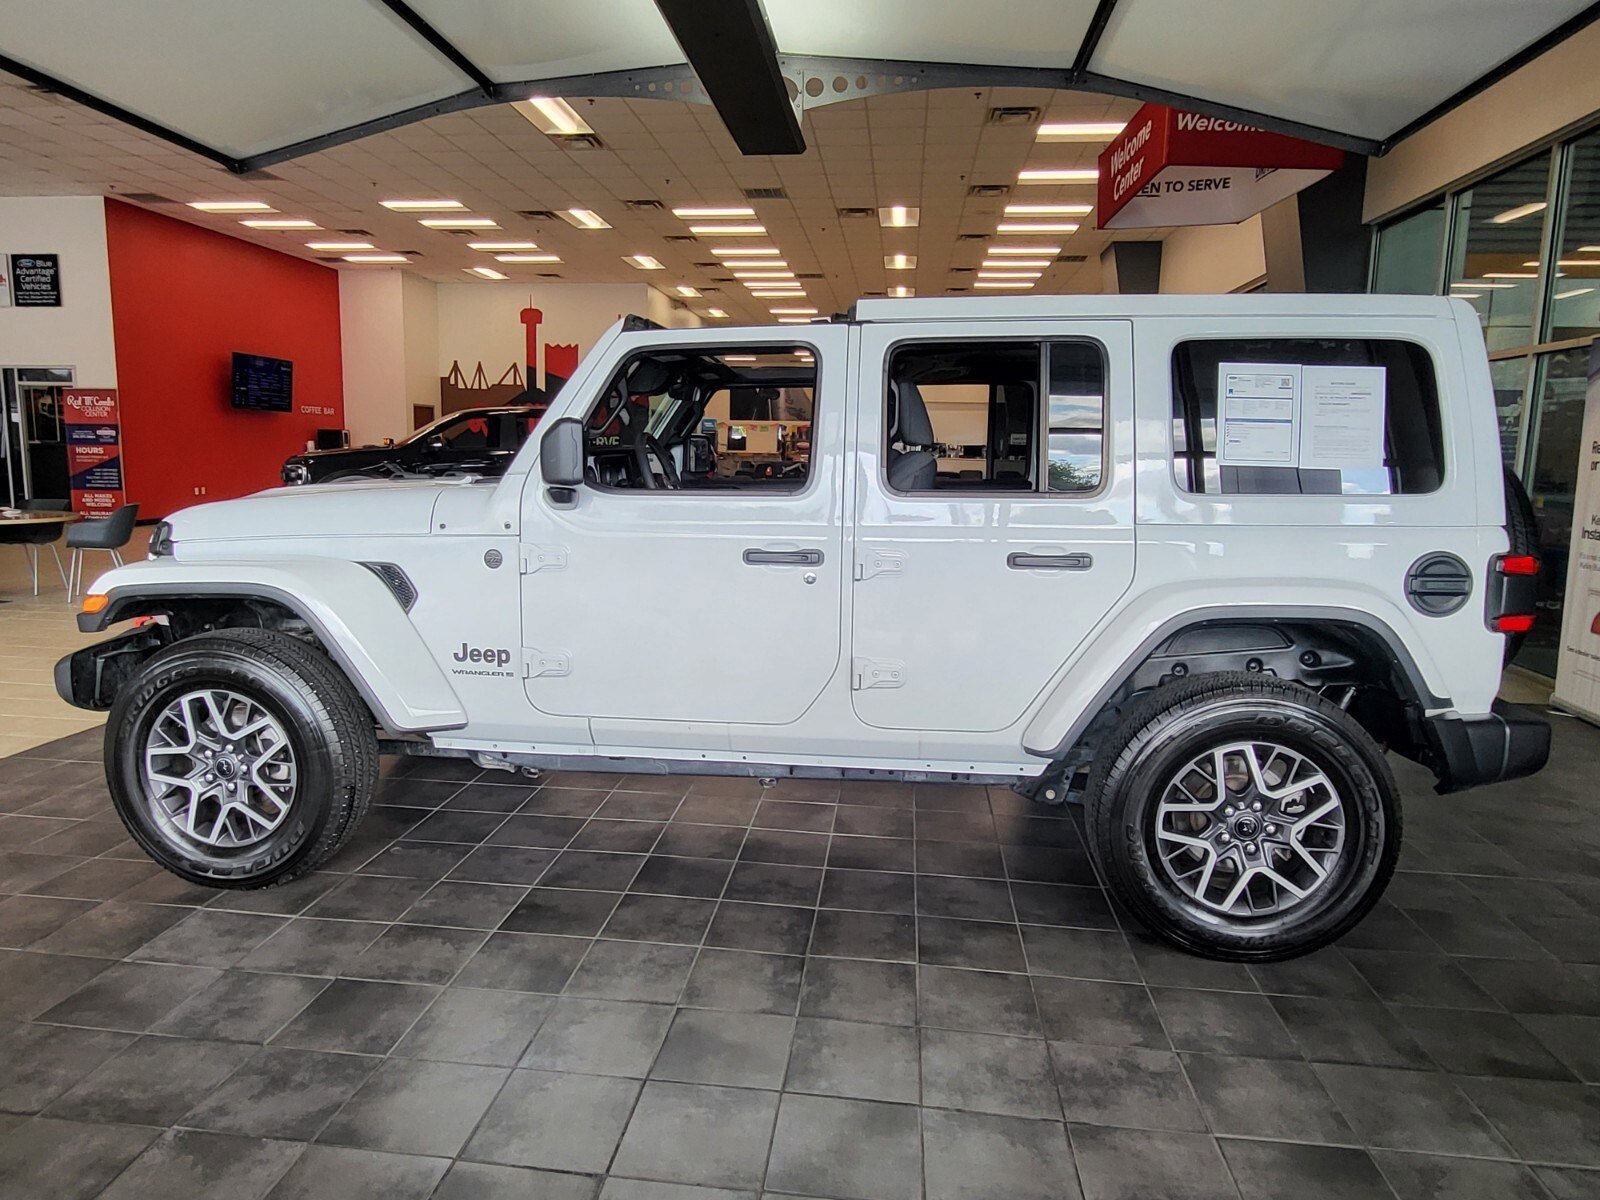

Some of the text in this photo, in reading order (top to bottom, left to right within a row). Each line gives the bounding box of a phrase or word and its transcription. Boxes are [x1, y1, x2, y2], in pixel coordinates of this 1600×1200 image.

[1177, 112, 1266, 132] Welcom
[1110, 120, 1152, 178] Welcome
[1113, 156, 1144, 201] Center
[1141, 177, 1231, 194] EN TO SERVE
[16, 268, 55, 276] Advantage
[301, 405, 335, 415] COFFEE BAR
[76, 446, 104, 454] HOURS
[453, 643, 510, 667] Jeep
[452, 669, 504, 677] WRANGLER
